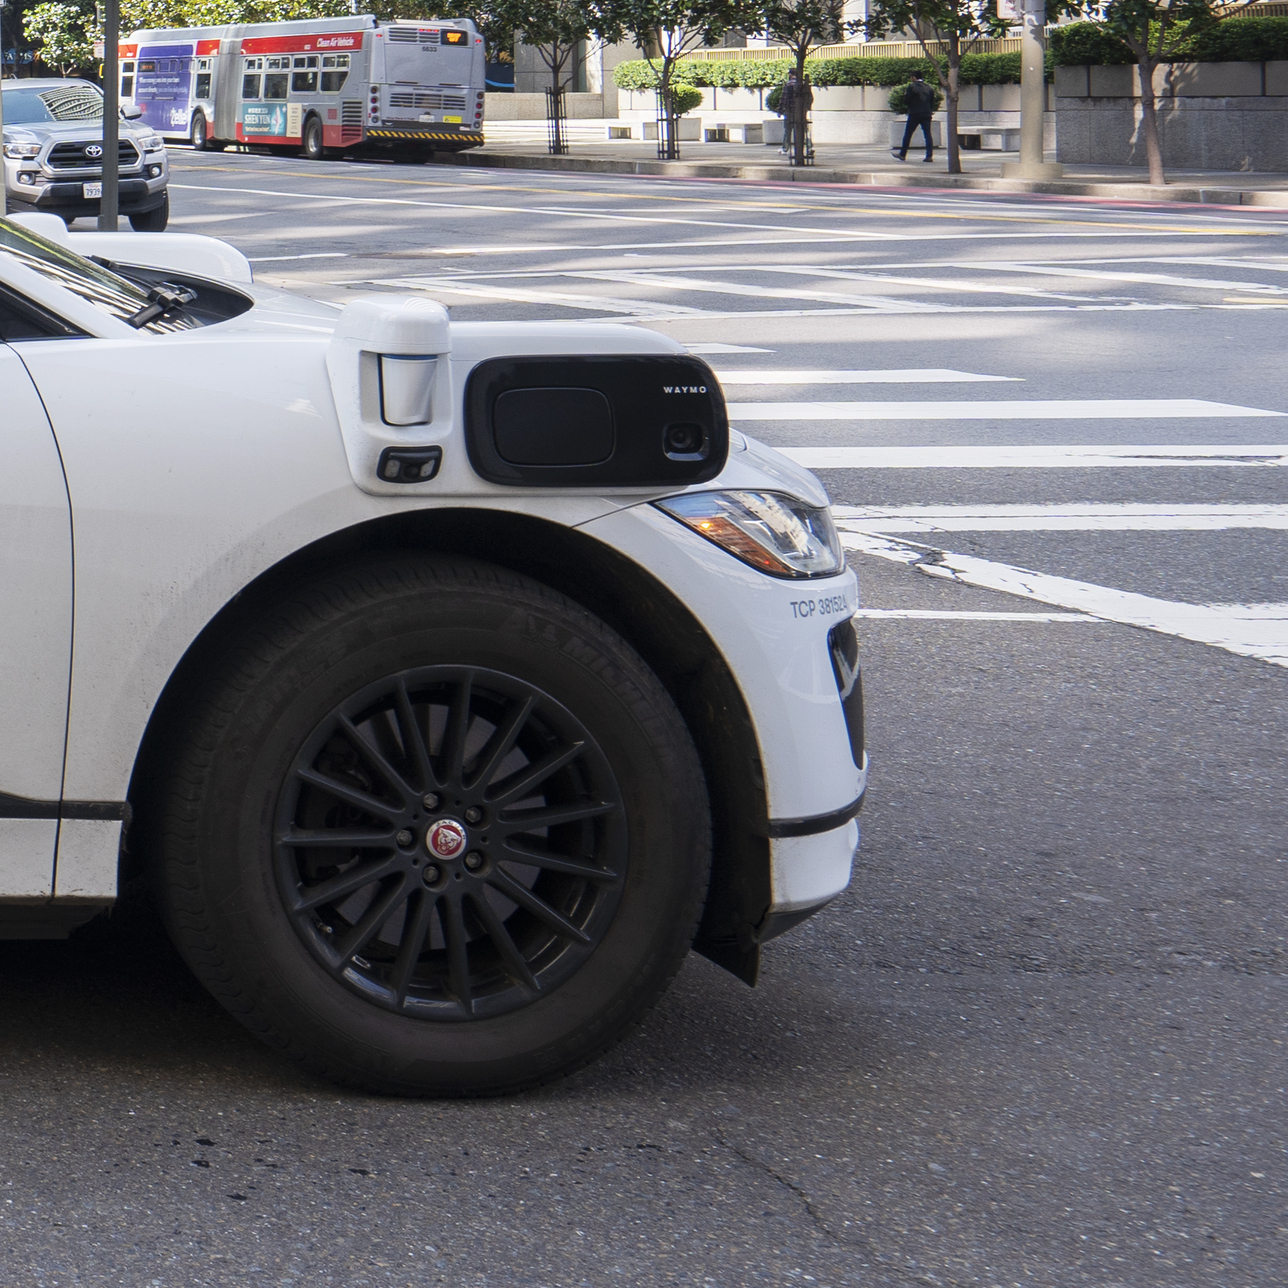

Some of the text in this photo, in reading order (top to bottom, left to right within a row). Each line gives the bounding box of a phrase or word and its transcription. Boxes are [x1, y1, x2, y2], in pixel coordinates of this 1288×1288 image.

[317, 38, 330, 47] Clean
[338, 37, 354, 46] Vehicle
[244, 115, 270, 124] SHEN YUN
[790, 600, 815, 618] TCP
